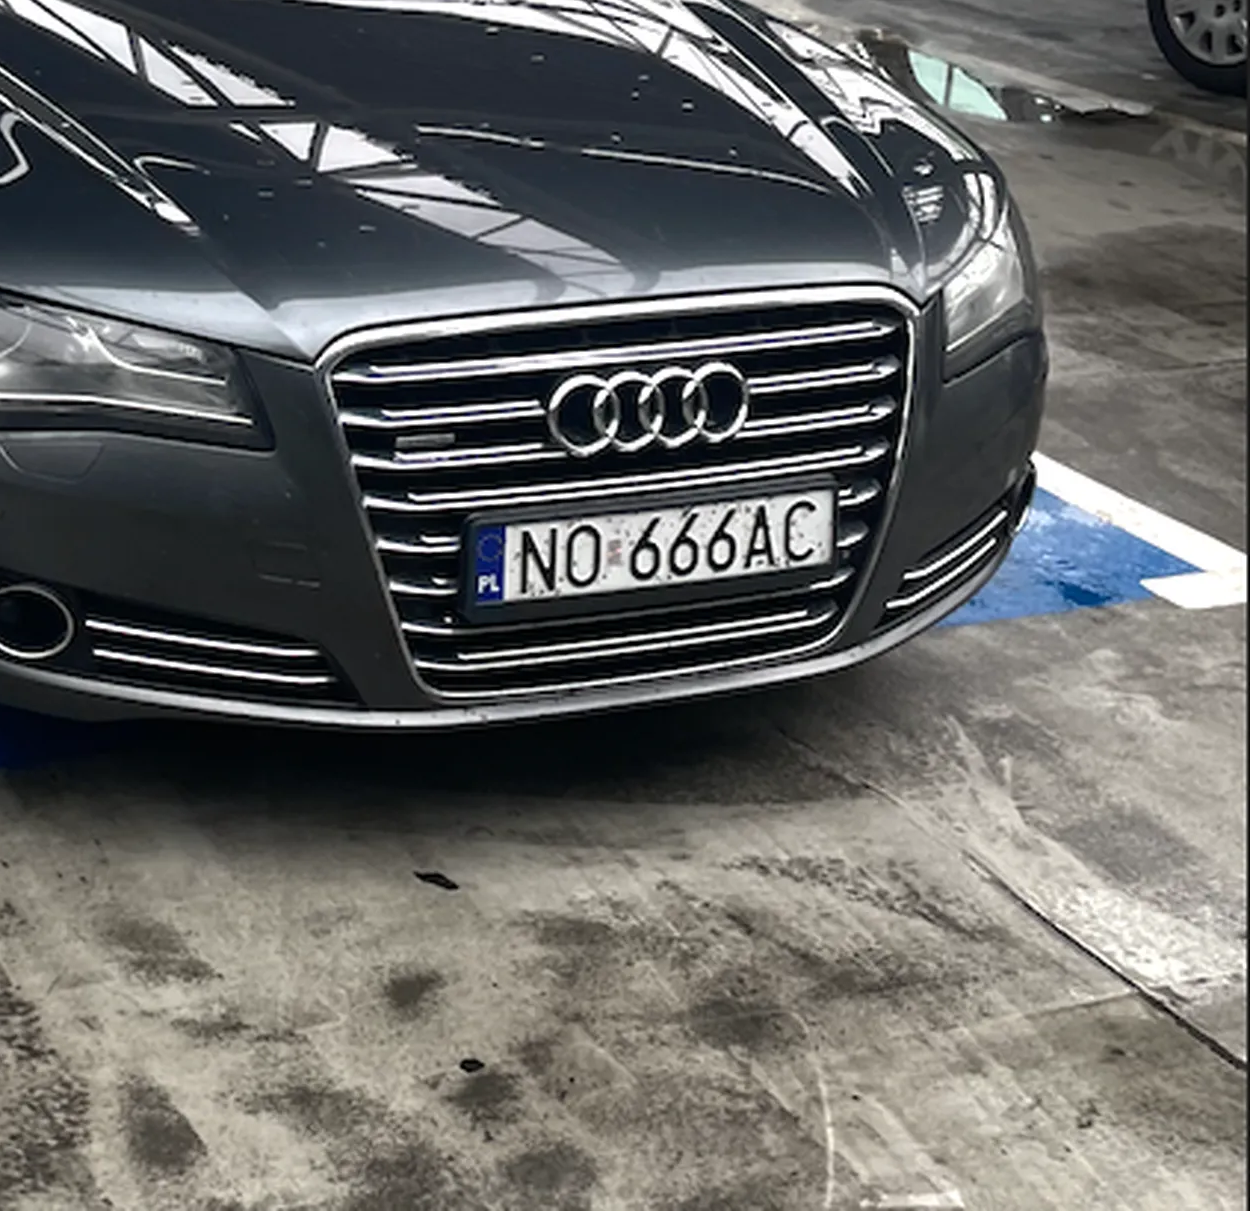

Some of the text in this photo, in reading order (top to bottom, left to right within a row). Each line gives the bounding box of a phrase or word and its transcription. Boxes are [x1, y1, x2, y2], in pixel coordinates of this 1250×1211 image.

[519, 500, 817, 594] NO 666AC
[477, 575, 500, 594] PL
